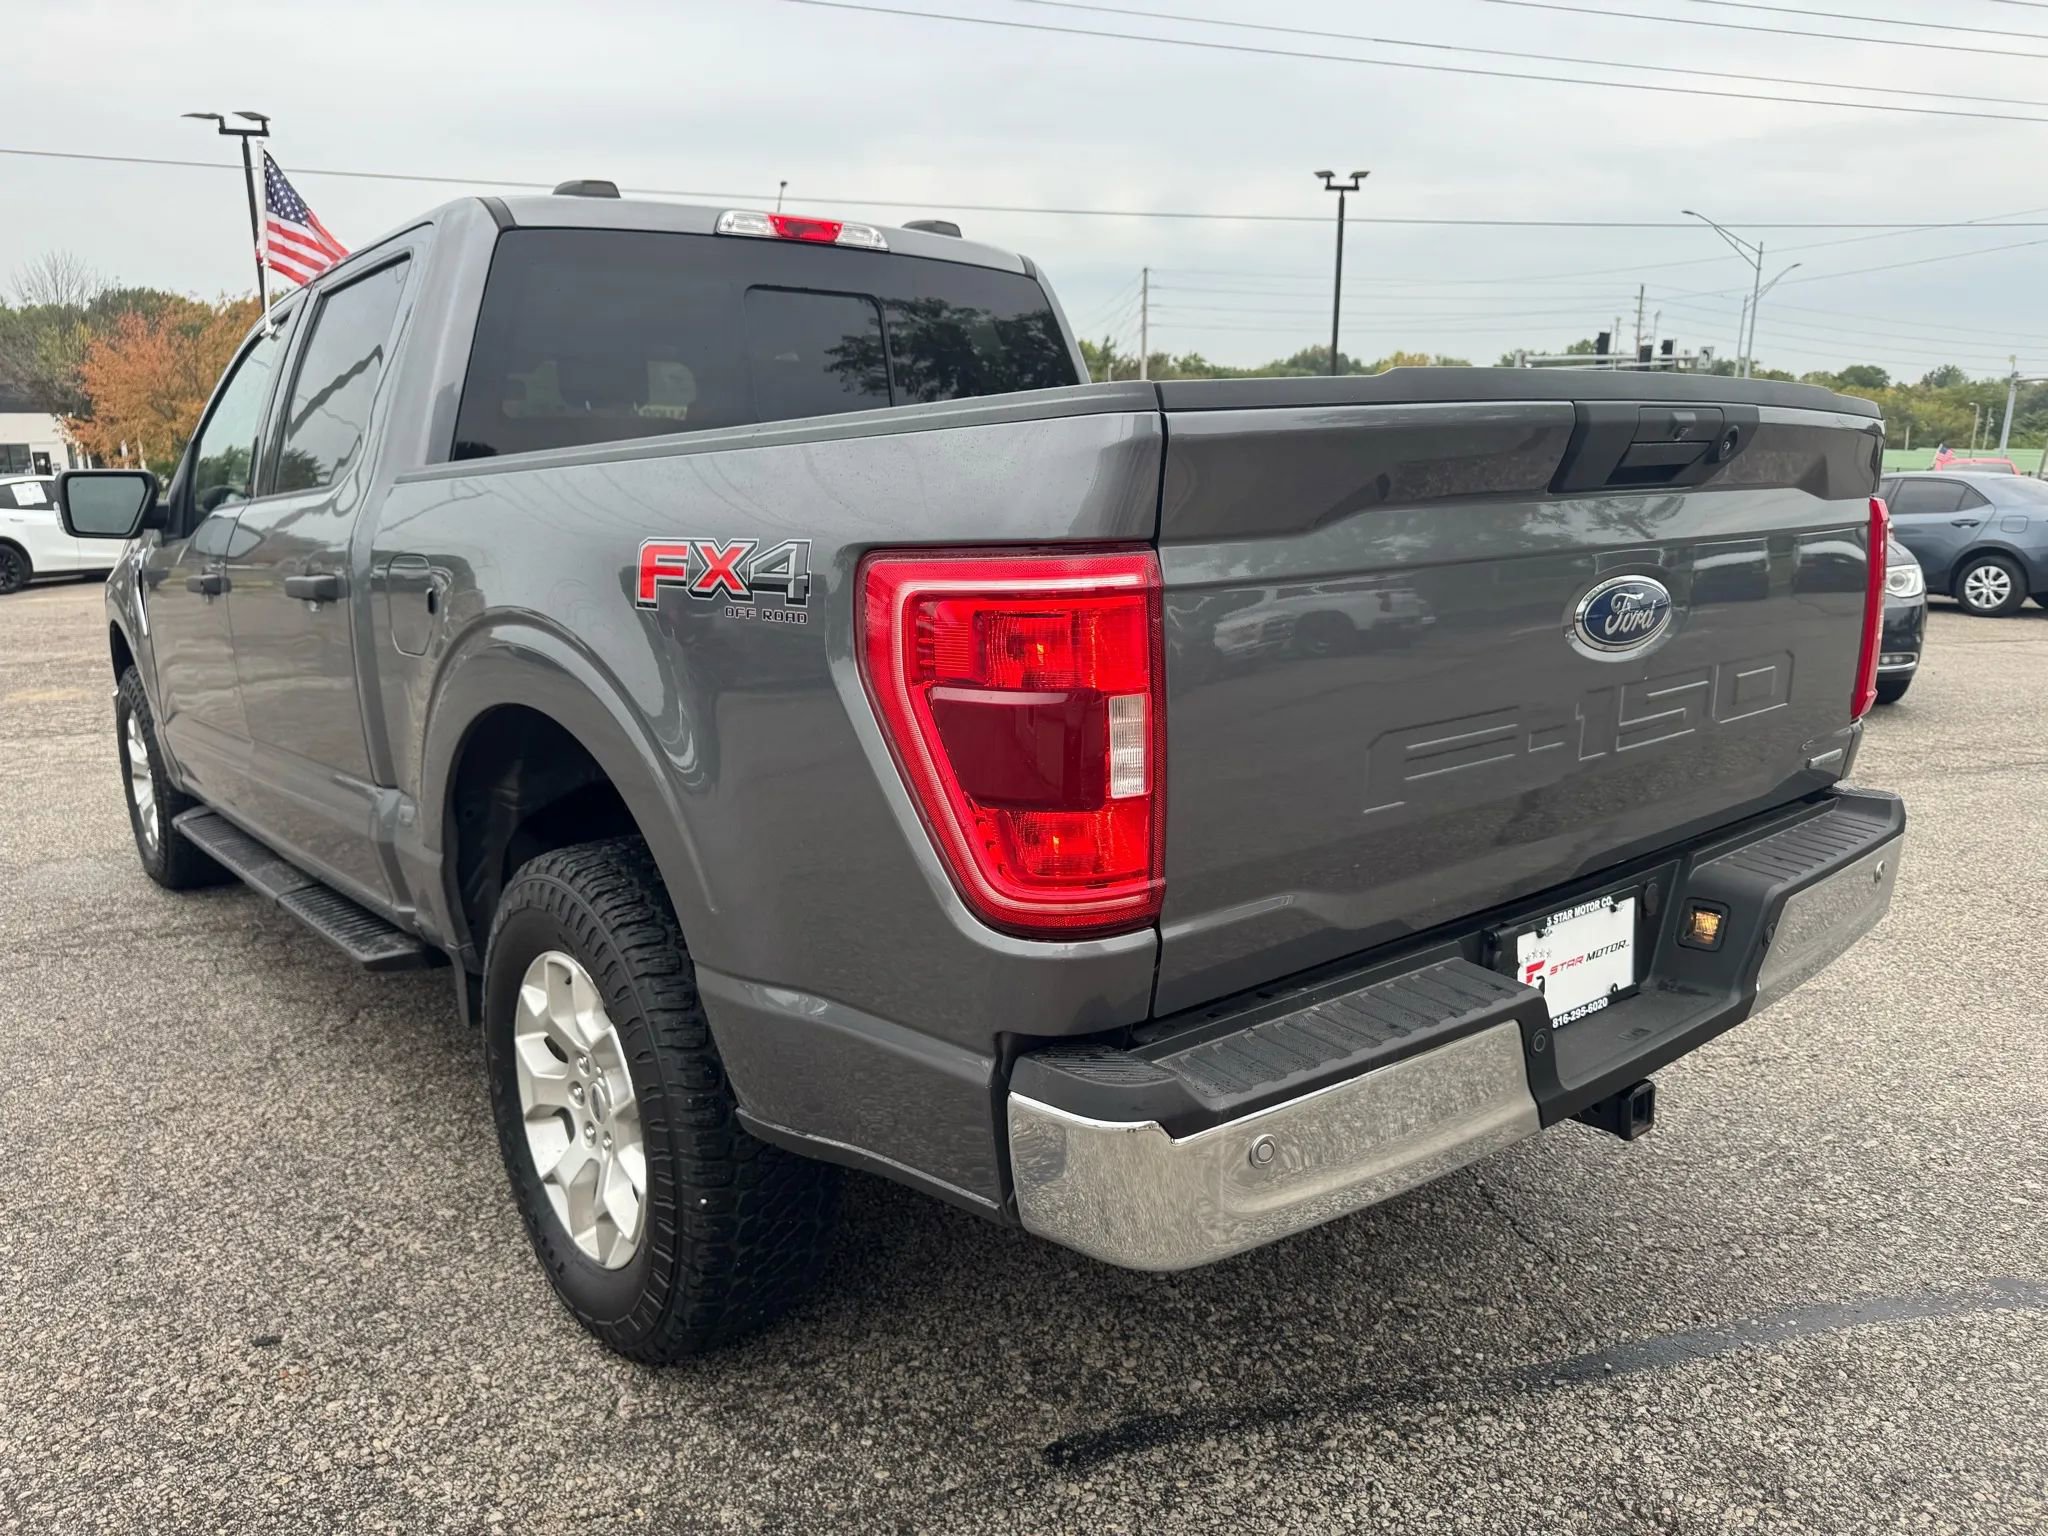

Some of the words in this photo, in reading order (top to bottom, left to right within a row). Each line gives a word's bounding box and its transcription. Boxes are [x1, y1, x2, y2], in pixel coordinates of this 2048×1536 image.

[635, 537, 812, 611] FX4
[724, 605, 757, 620] OFF
[761, 608, 808, 625] ROAD
[1604, 592, 1657, 636] Ford
[1363, 650, 1795, 814] F-150
[1546, 916, 1553, 927] 5
[1553, 909, 1574, 925] STAR
[1574, 899, 1601, 917] MOTOR
[1550, 955, 1584, 976] STAR
[1585, 939, 1627, 962] MOTOR
[1552, 996, 1609, 1029] 816-295-6020
